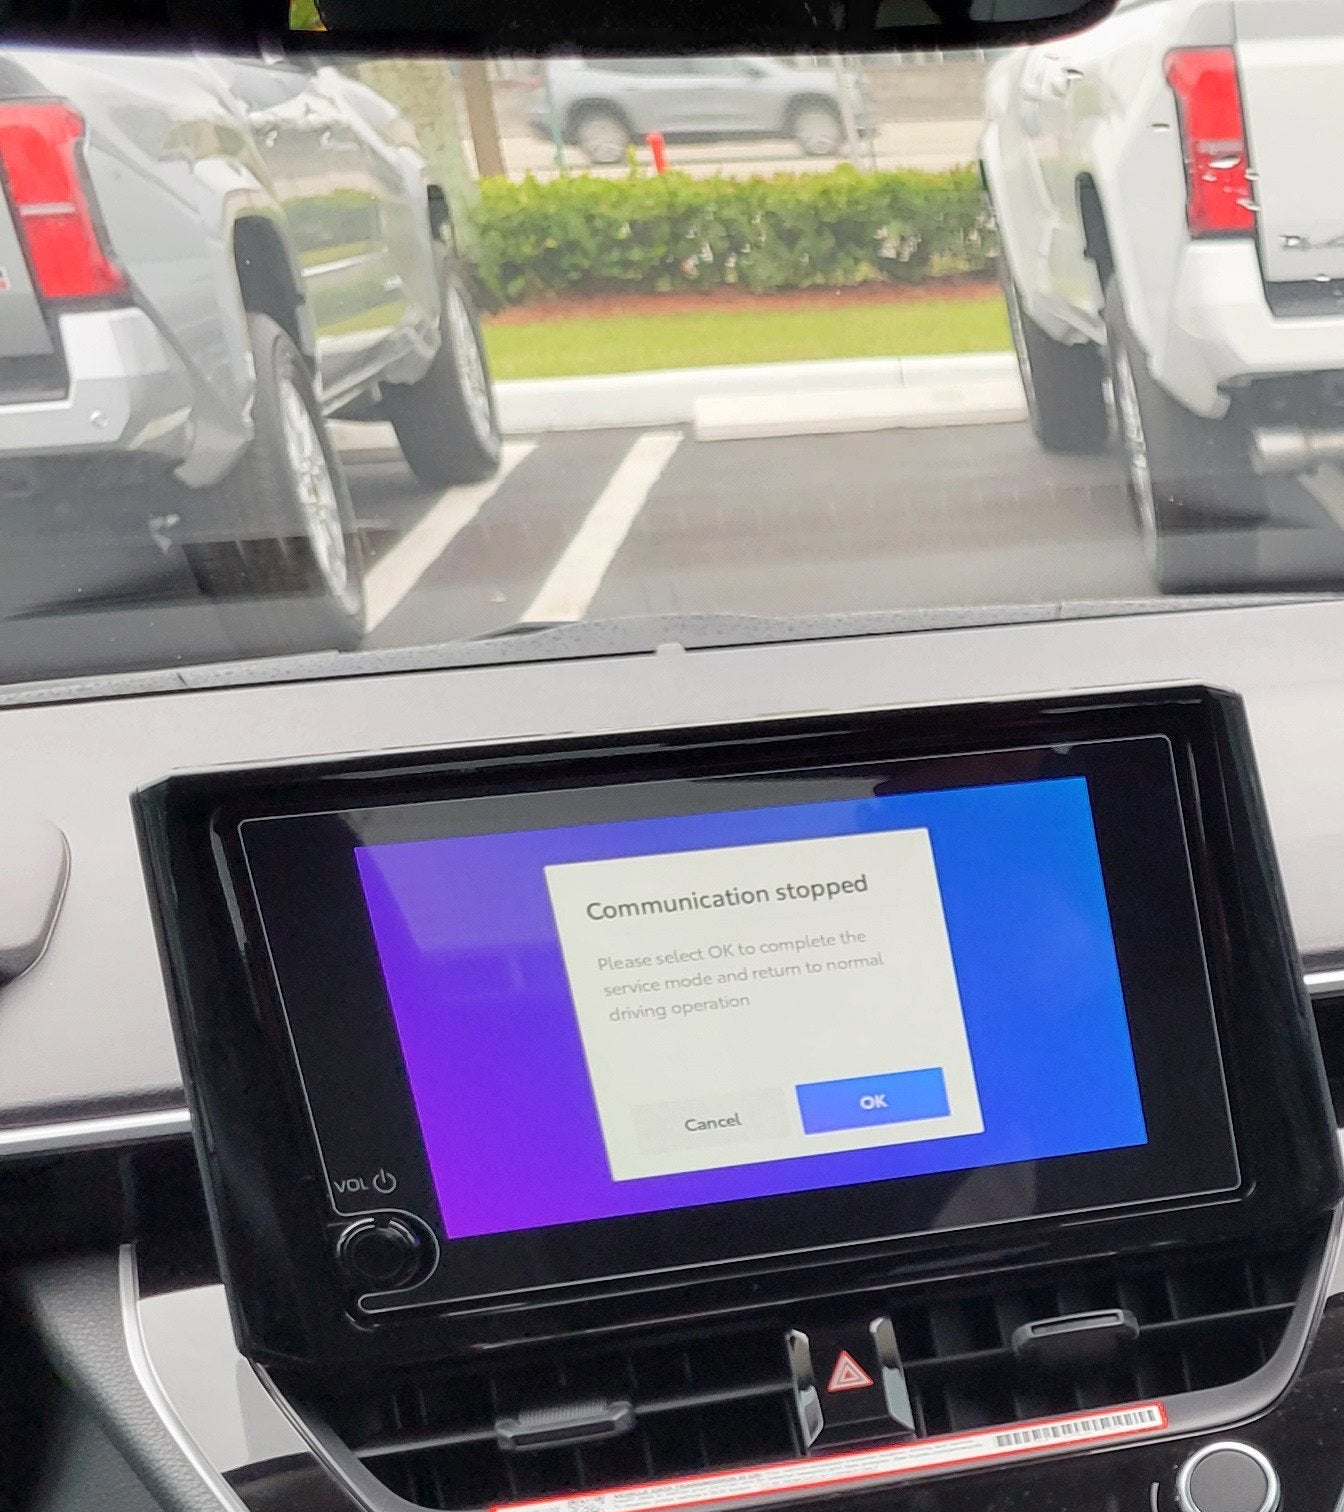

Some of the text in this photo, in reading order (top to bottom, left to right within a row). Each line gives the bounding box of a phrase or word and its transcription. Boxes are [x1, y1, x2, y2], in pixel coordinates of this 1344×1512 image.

[587, 874, 869, 921] Communication stopped
[598, 930, 867, 971] Please select OK to complete the
[604, 952, 884, 997] service mode and return to normal
[609, 995, 750, 1023] driving operation
[860, 1094, 889, 1110] OK
[684, 1113, 742, 1132] Cancel
[333, 1177, 370, 1194] VOL
